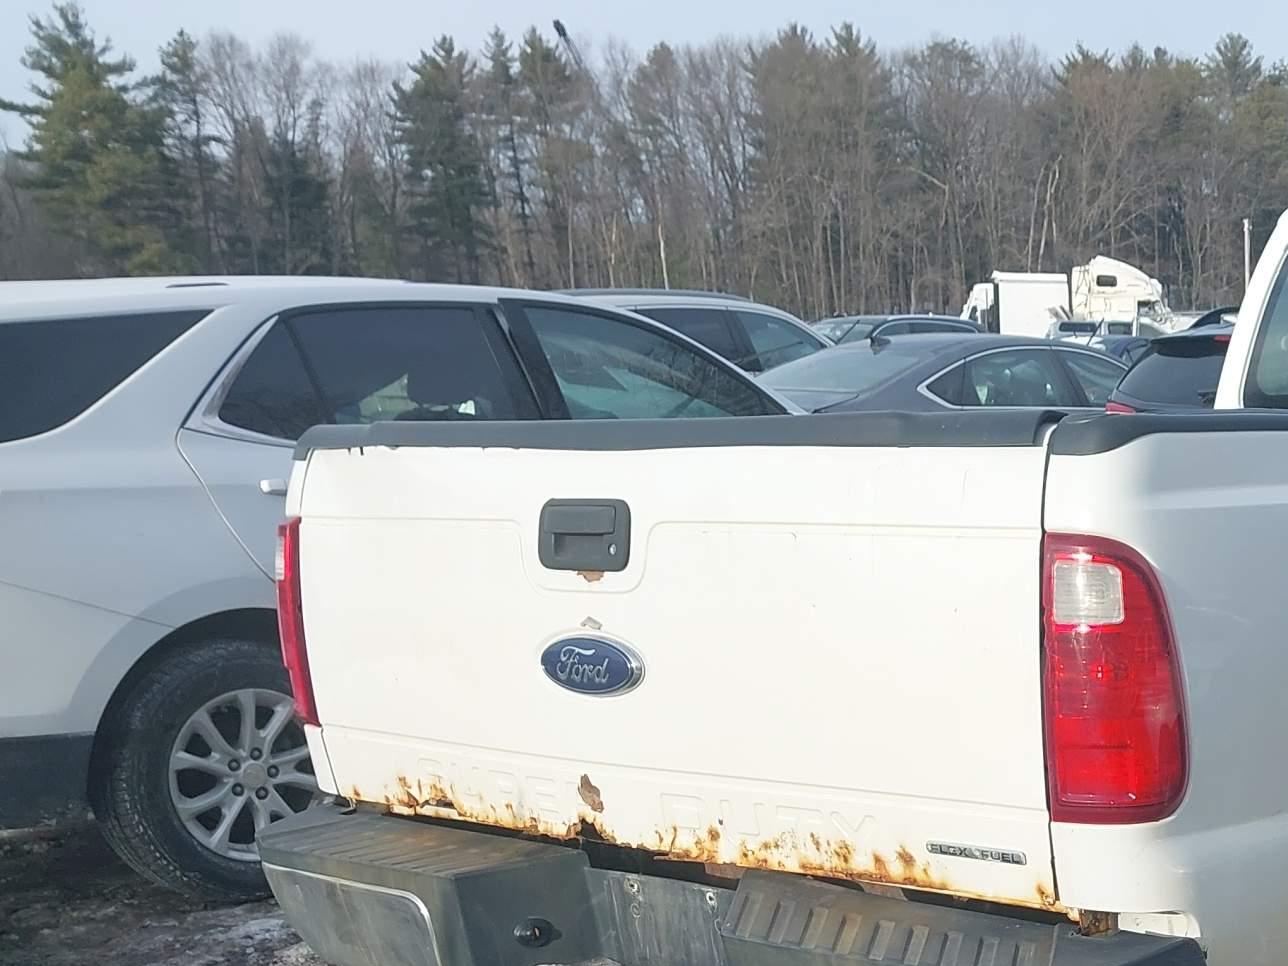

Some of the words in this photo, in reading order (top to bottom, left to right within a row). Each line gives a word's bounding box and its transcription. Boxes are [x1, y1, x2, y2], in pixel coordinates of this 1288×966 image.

[556, 646, 609, 684] Ford
[930, 843, 971, 858] FLEX
[981, 850, 1024, 864] FUEL
